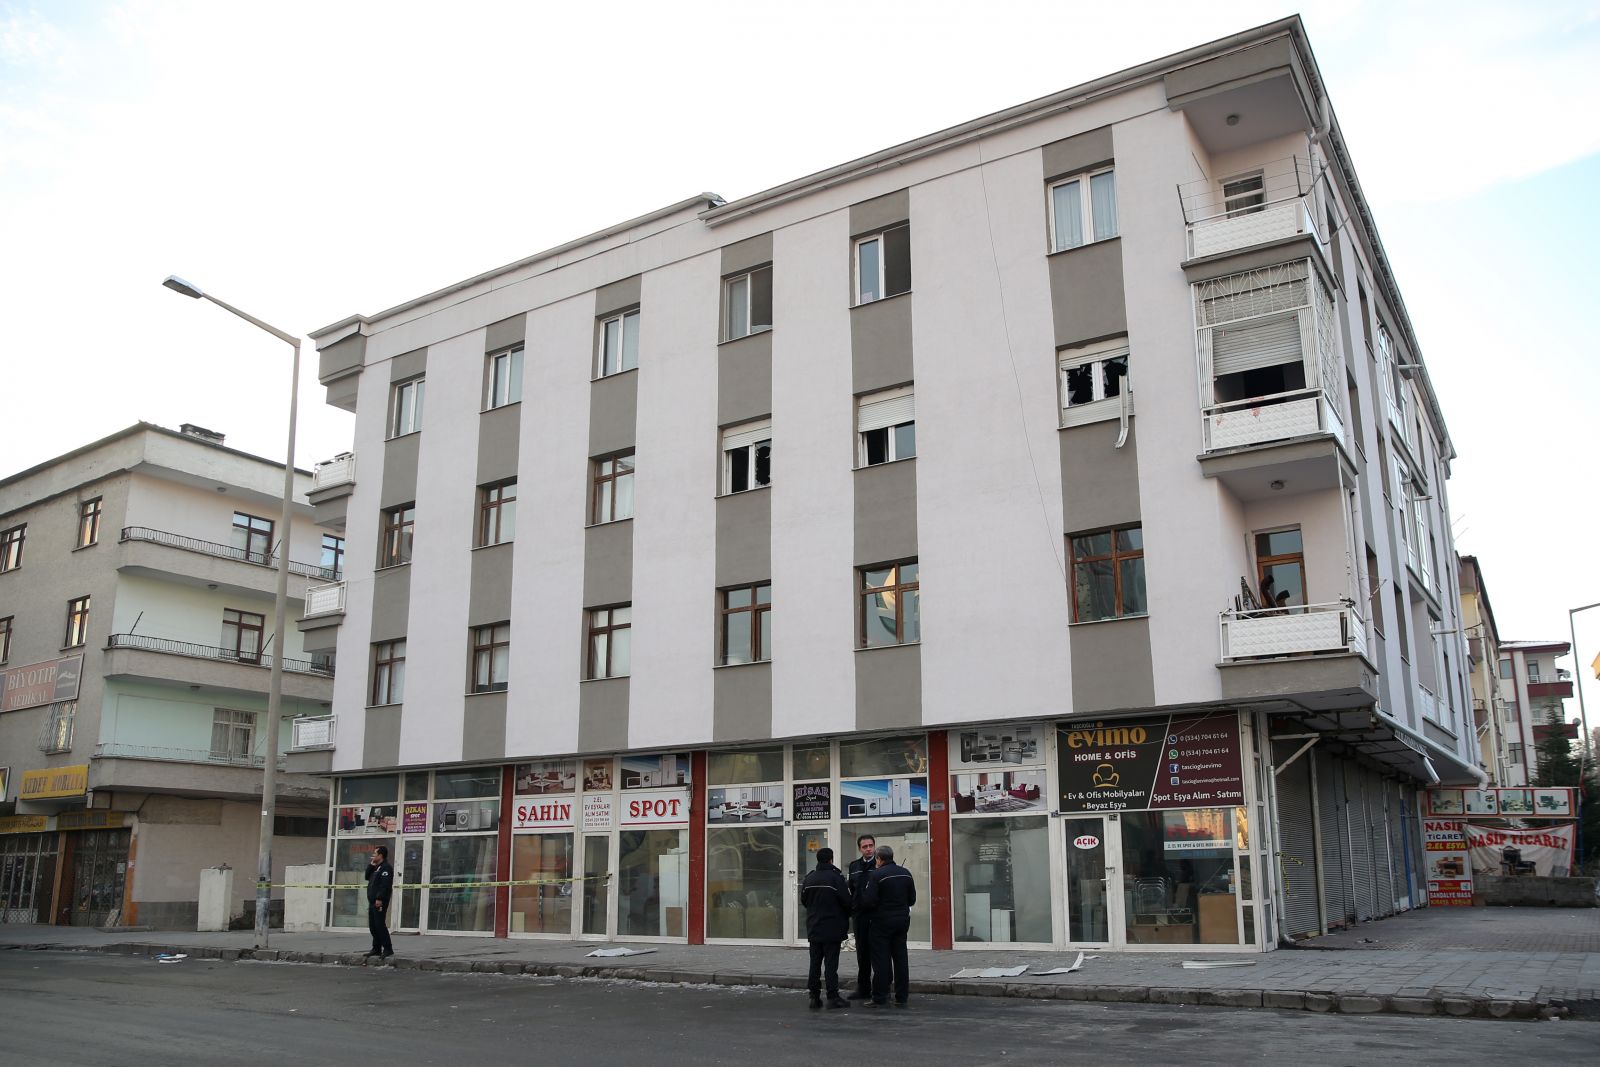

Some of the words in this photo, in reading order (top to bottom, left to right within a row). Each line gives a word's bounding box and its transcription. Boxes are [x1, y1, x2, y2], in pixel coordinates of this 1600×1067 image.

[1067, 721, 1146, 748] evimo
[1074, 753, 1102, 762] HOME
[1104, 752, 1112, 760] &
[1114, 749, 1137, 759] OFİS
[1068, 792, 1076, 800] Ev
[1086, 790, 1101, 799] Ofis
[1103, 789, 1145, 800] Mobilyaları
[1153, 793, 1170, 803] Spot
[1173, 792, 1191, 802] Eşya
[1192, 791, 1210, 800] Alım
[1216, 790, 1241, 799] Satımı
[629, 799, 681, 818] SPOT
[1086, 802, 1108, 811] Beyaz
[1109, 801, 1127, 810] Eşya
[517, 800, 572, 827] ŞAHİN
[1076, 837, 1097, 847] AÇIK
